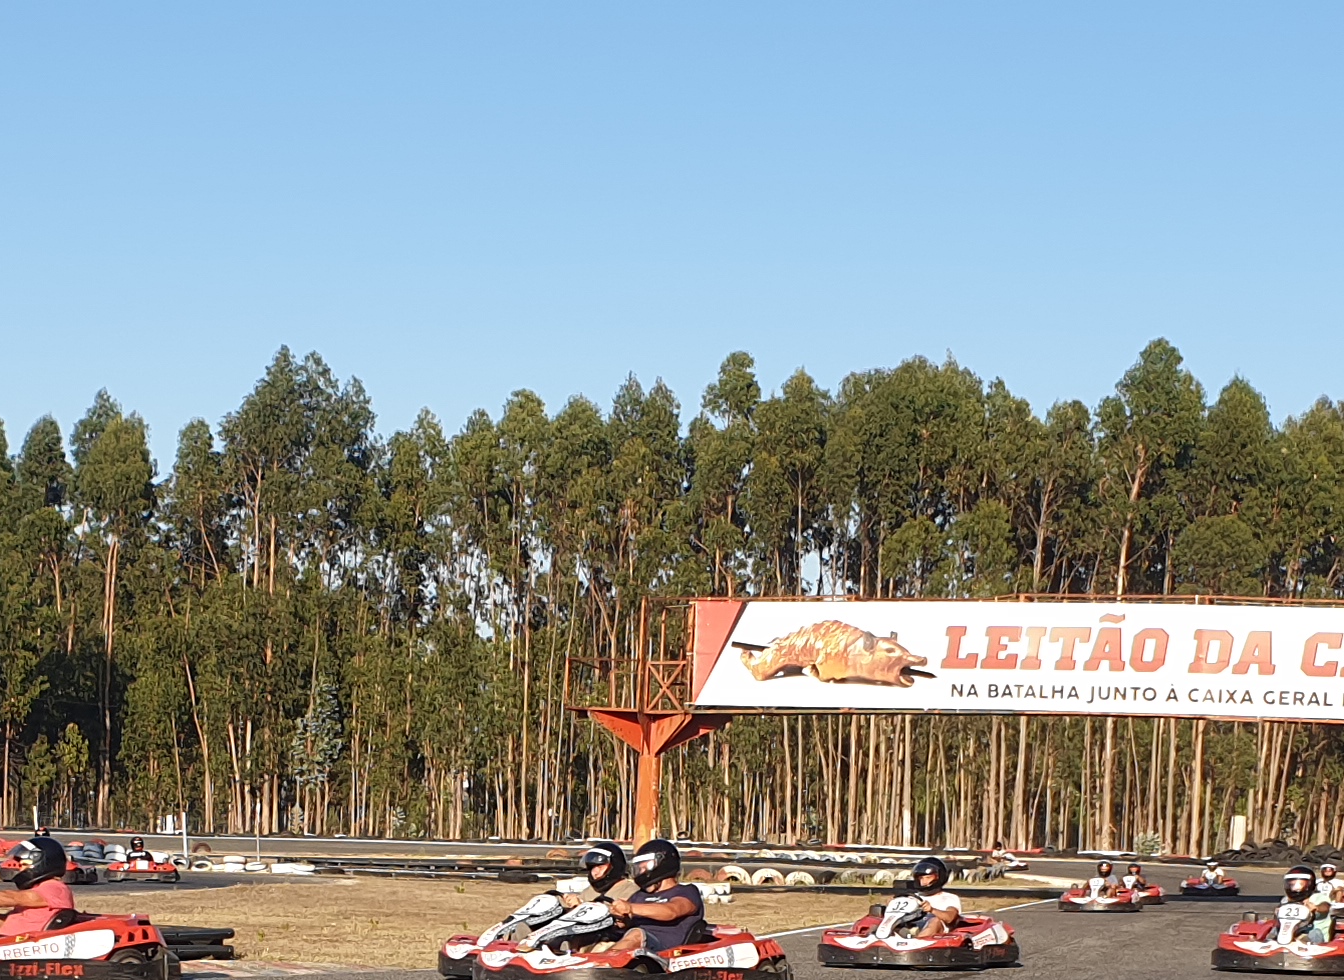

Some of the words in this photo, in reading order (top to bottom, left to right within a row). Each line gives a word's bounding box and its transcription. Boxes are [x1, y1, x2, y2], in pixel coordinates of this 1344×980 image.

[940, 613, 1170, 673] LEITÃO
[1187, 628, 1276, 676] DA
[950, 683, 978, 698] NA
[987, 683, 1079, 700] BATALHA
[1086, 686, 1157, 704] JUNTO
[1187, 688, 1254, 705] CAIXA
[1262, 690, 1334, 707] GERAL
[1284, 907, 1300, 917] 23
